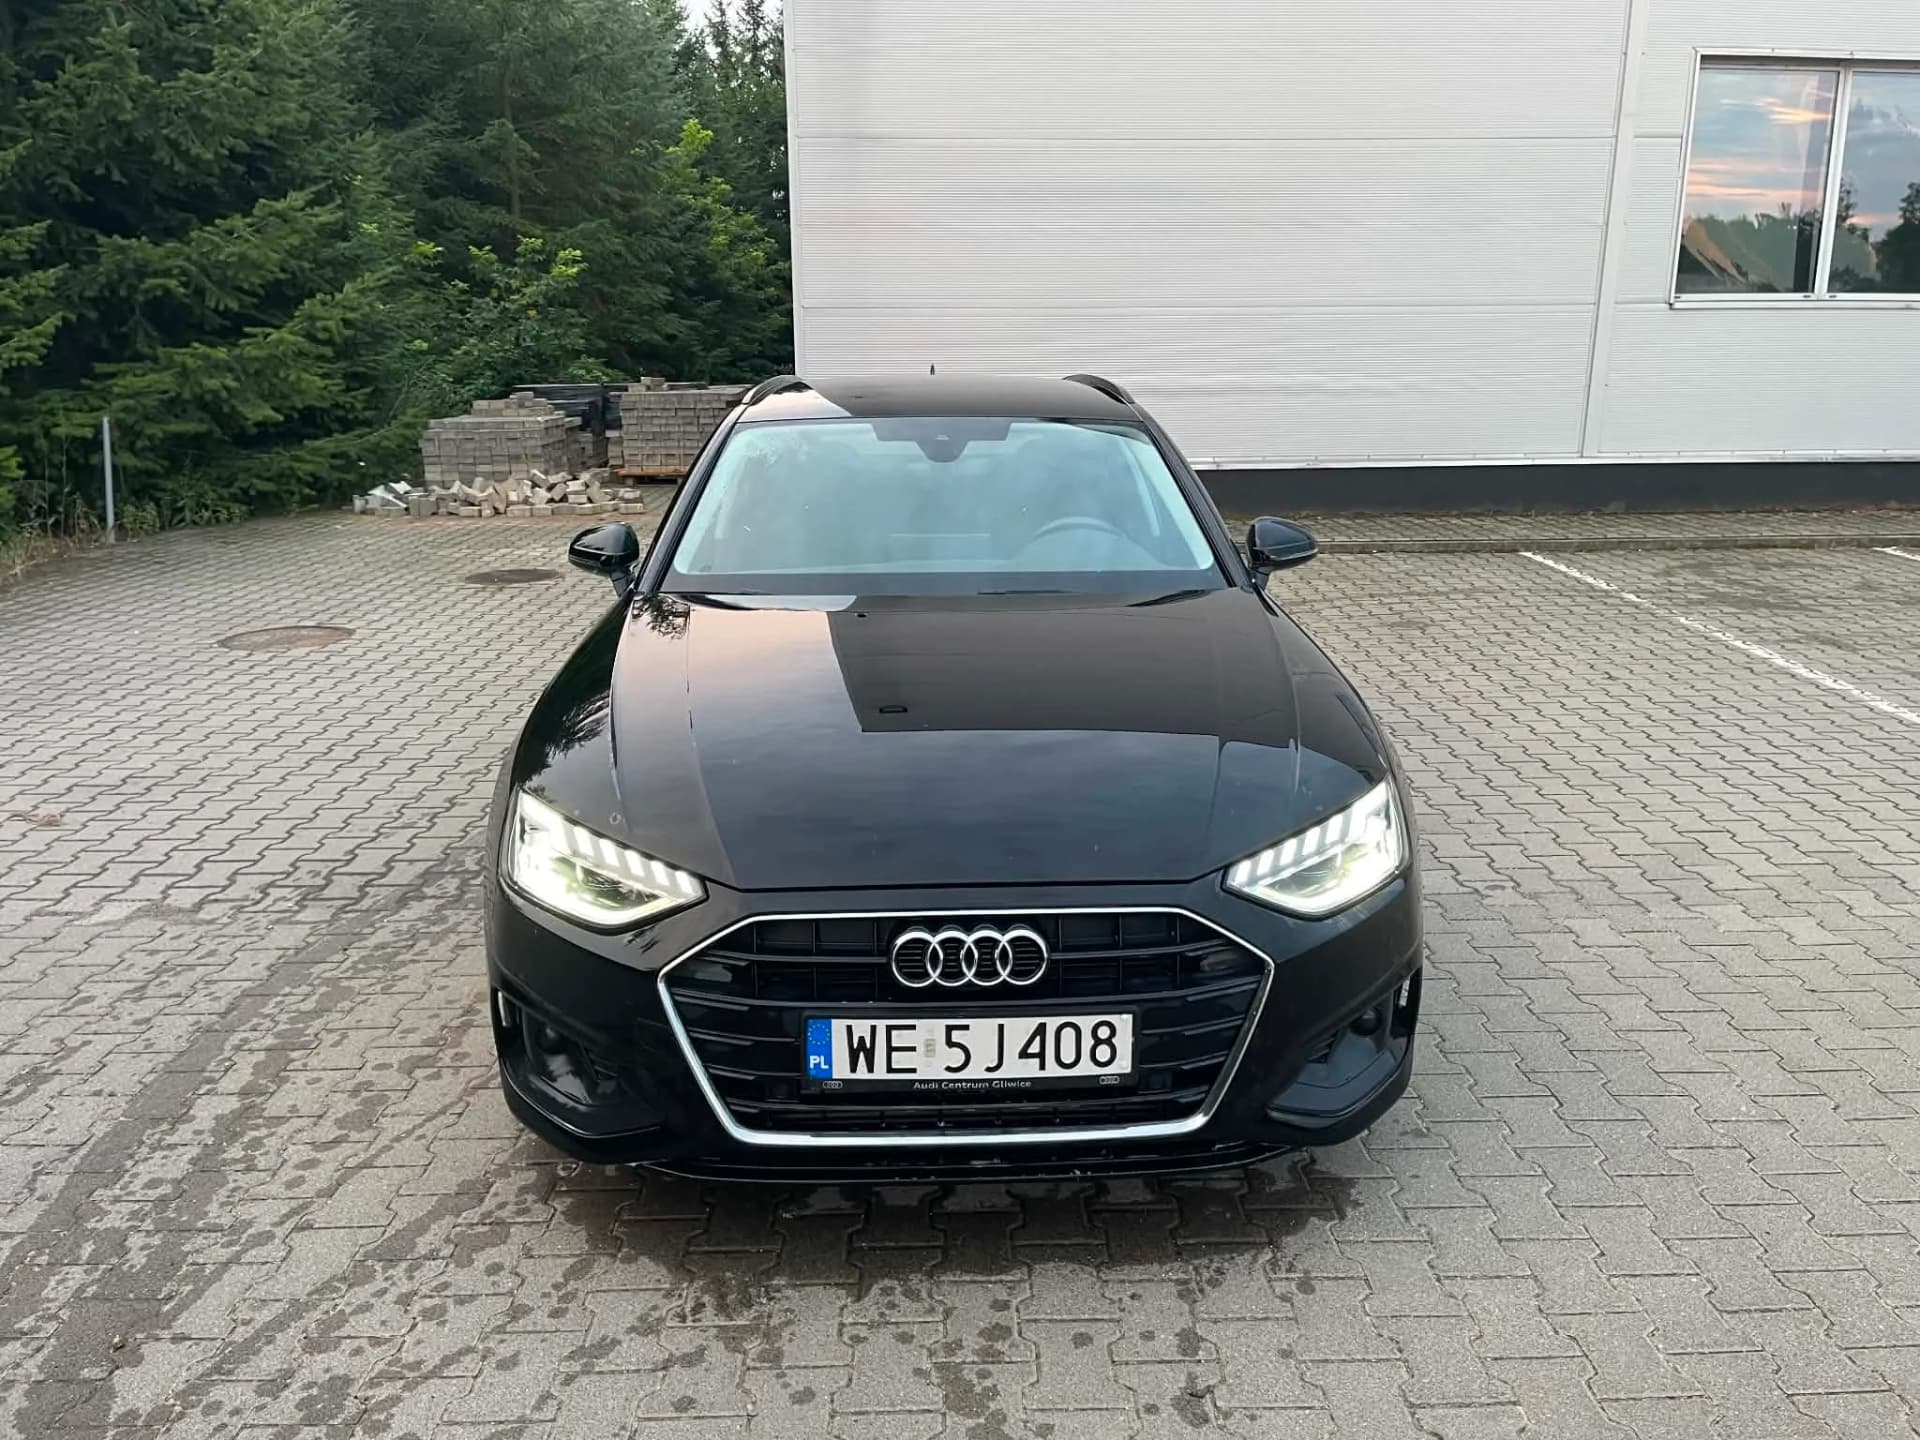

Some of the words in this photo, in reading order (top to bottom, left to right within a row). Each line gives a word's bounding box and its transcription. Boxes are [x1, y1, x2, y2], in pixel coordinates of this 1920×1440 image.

[846, 1024, 917, 1074] WE
[944, 1020, 1117, 1074] 5J408
[809, 1055, 829, 1070] PL
[913, 1081, 939, 1090] Audi
[941, 1081, 989, 1090] Centrum
[992, 1080, 1032, 1089] Gliwice
